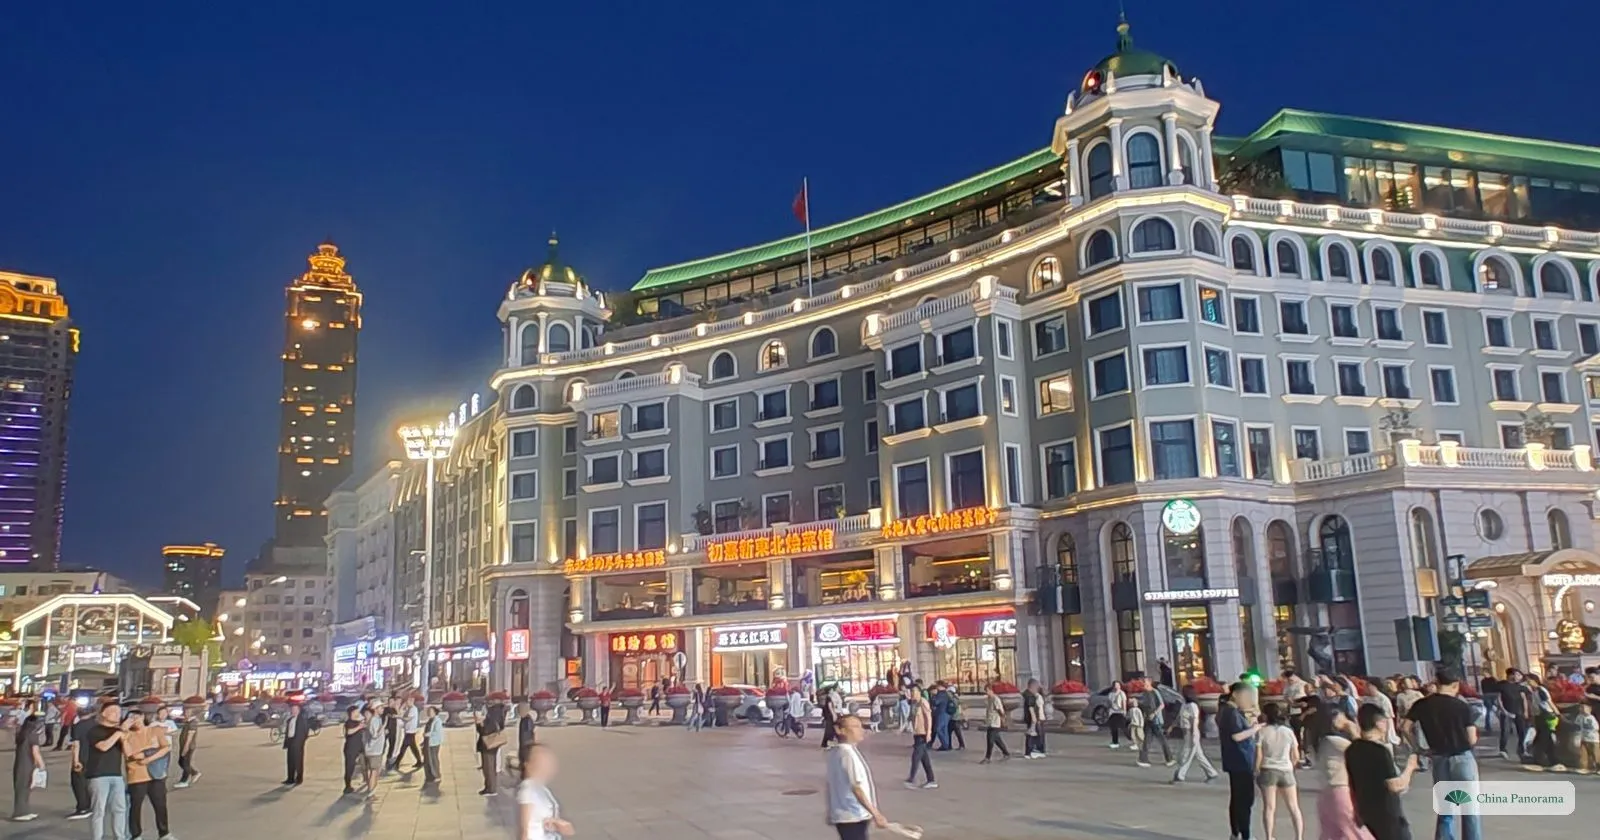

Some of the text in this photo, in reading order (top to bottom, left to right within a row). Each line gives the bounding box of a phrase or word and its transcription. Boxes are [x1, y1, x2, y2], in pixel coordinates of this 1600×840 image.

[1143, 588, 1239, 601] STARBUCKS COFFEE
[982, 618, 1017, 635] KFC
